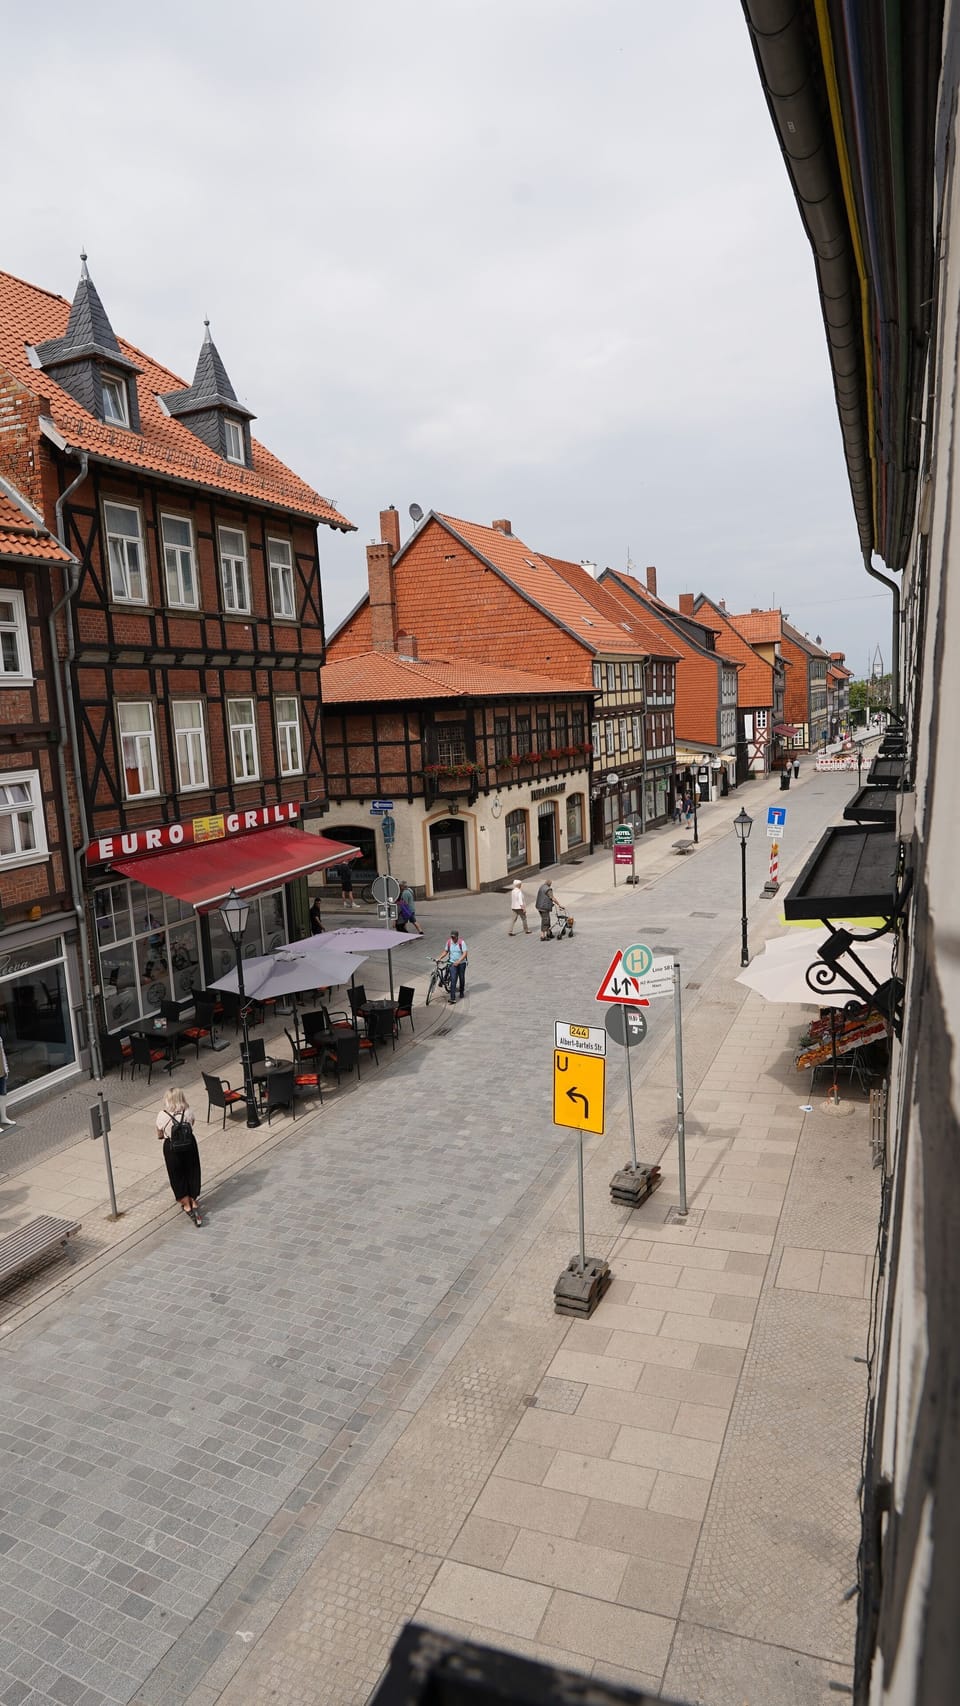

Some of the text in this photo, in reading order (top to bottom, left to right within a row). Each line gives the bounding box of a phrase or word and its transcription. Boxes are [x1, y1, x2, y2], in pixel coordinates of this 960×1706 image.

[98, 824, 184, 860] EURO
[227, 802, 298, 833] GRILL
[571, 1026, 587, 1037] 244
[557, 1055, 568, 1071] U
